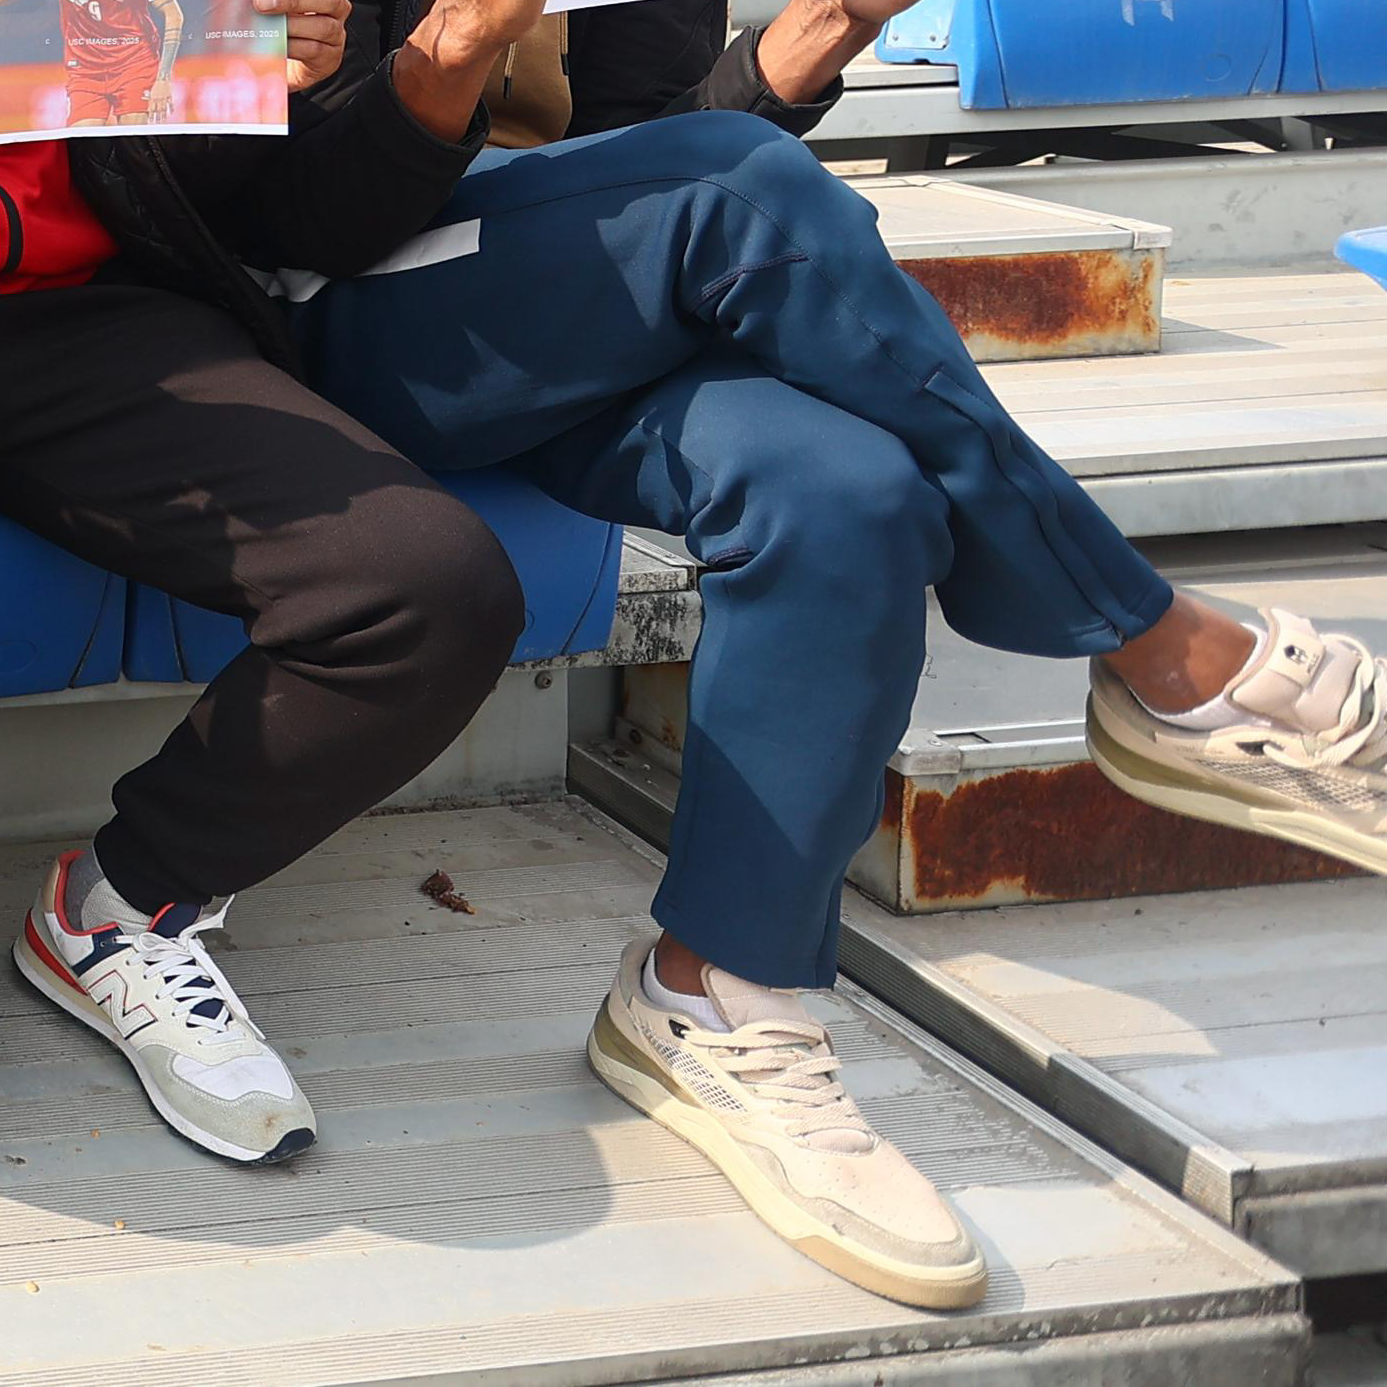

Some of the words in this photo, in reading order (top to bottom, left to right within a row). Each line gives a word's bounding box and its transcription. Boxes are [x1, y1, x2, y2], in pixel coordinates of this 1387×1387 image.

[205, 30, 221, 40] USC
[222, 29, 257, 39] IMAGES,
[68, 37, 84, 46] USC
[85, 37, 119, 46] IMAGES,
